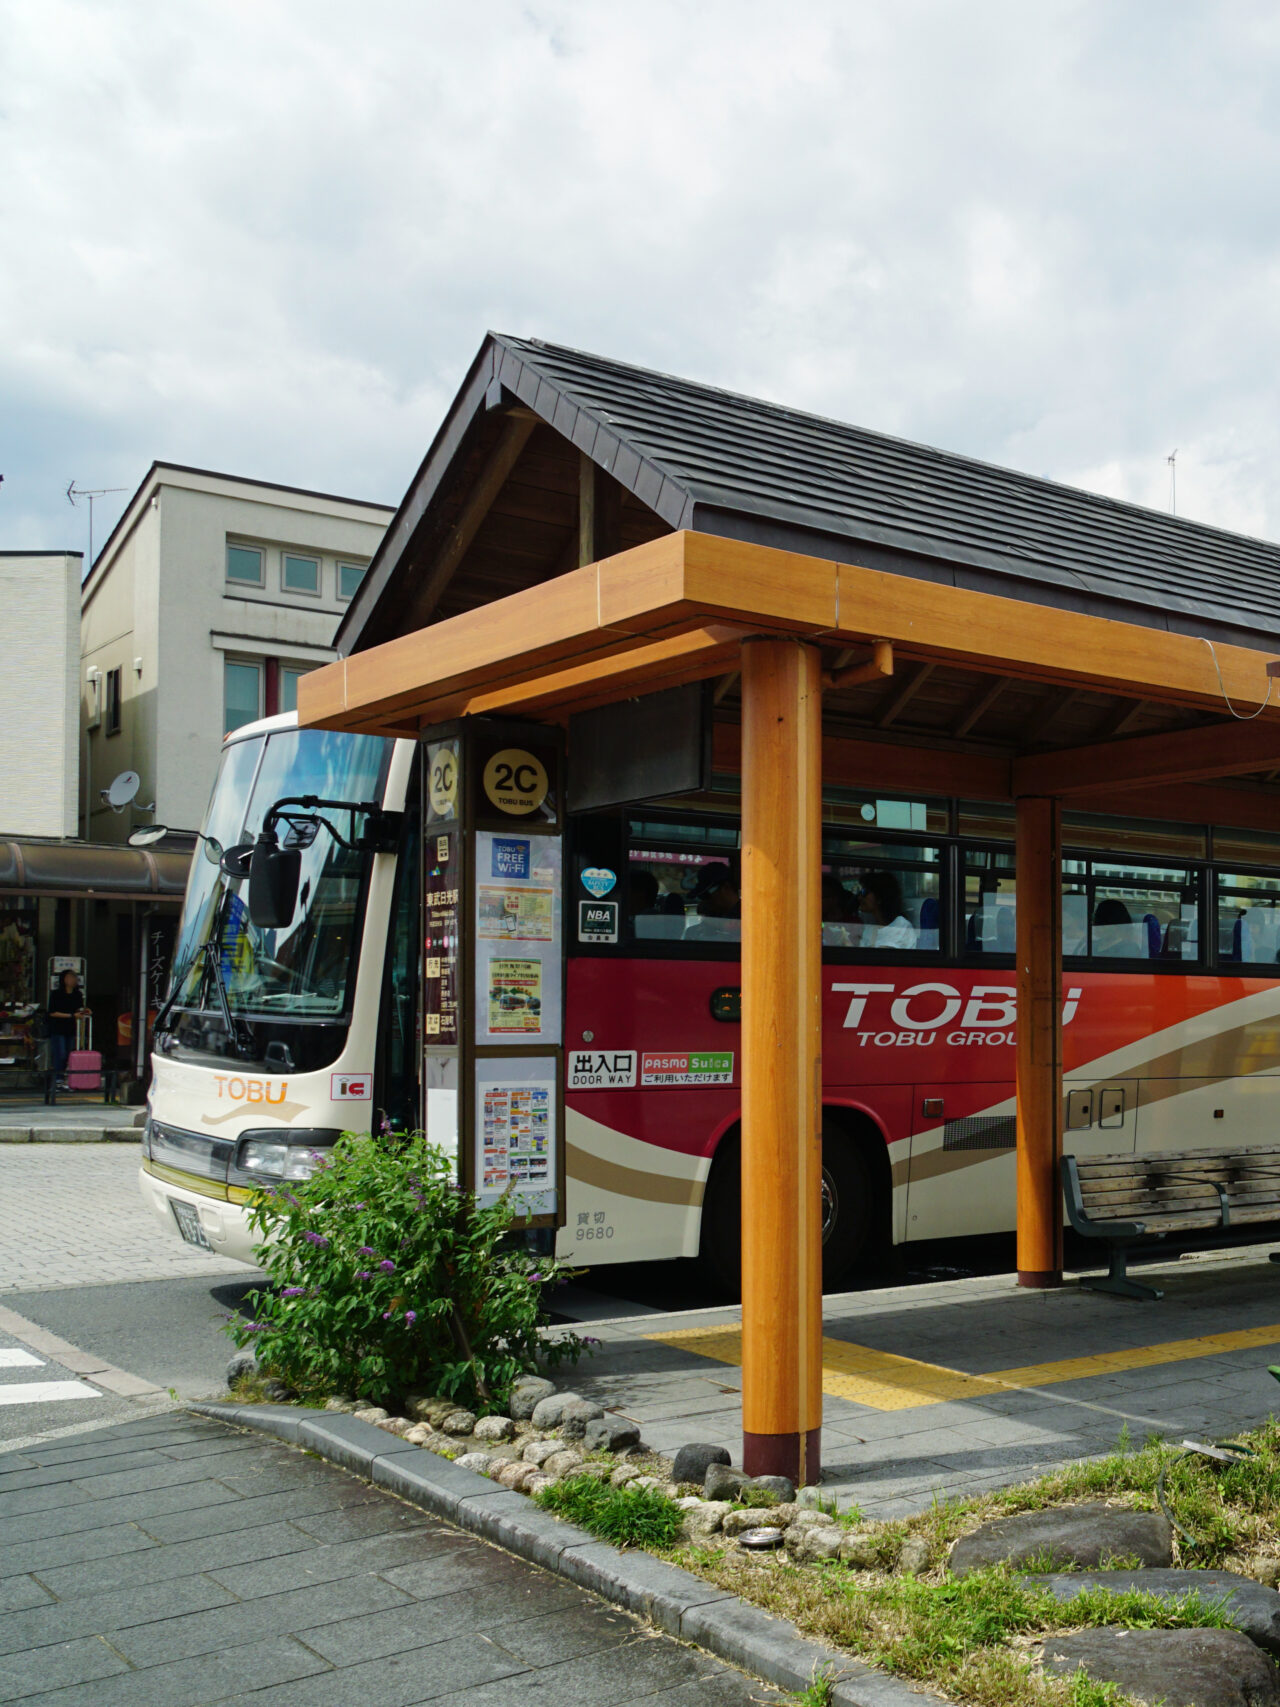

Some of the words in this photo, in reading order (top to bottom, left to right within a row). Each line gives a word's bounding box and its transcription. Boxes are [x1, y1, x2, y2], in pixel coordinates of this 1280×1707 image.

[434, 763, 452, 793] 2C
[494, 763, 538, 793] 2C
[497, 853, 525, 863] FREE
[498, 863, 525, 873] Wi-Fi
[426, 889, 459, 906] 東武日光駅
[586, 910, 611, 921] NBA
[150, 930, 166, 1010] チーズケーキ
[857, 1032, 937, 1046] TOBU
[574, 1054, 632, 1074] 出入口
[645, 1058, 687, 1069] PASMO
[691, 1058, 729, 1068] Suica
[572, 1075, 602, 1085] DOOR
[608, 1075, 632, 1084] WAY
[644, 1073, 730, 1083] ご利用いただけます
[214, 1075, 288, 1104] TOBU
[576, 1226, 614, 1241] 9680
